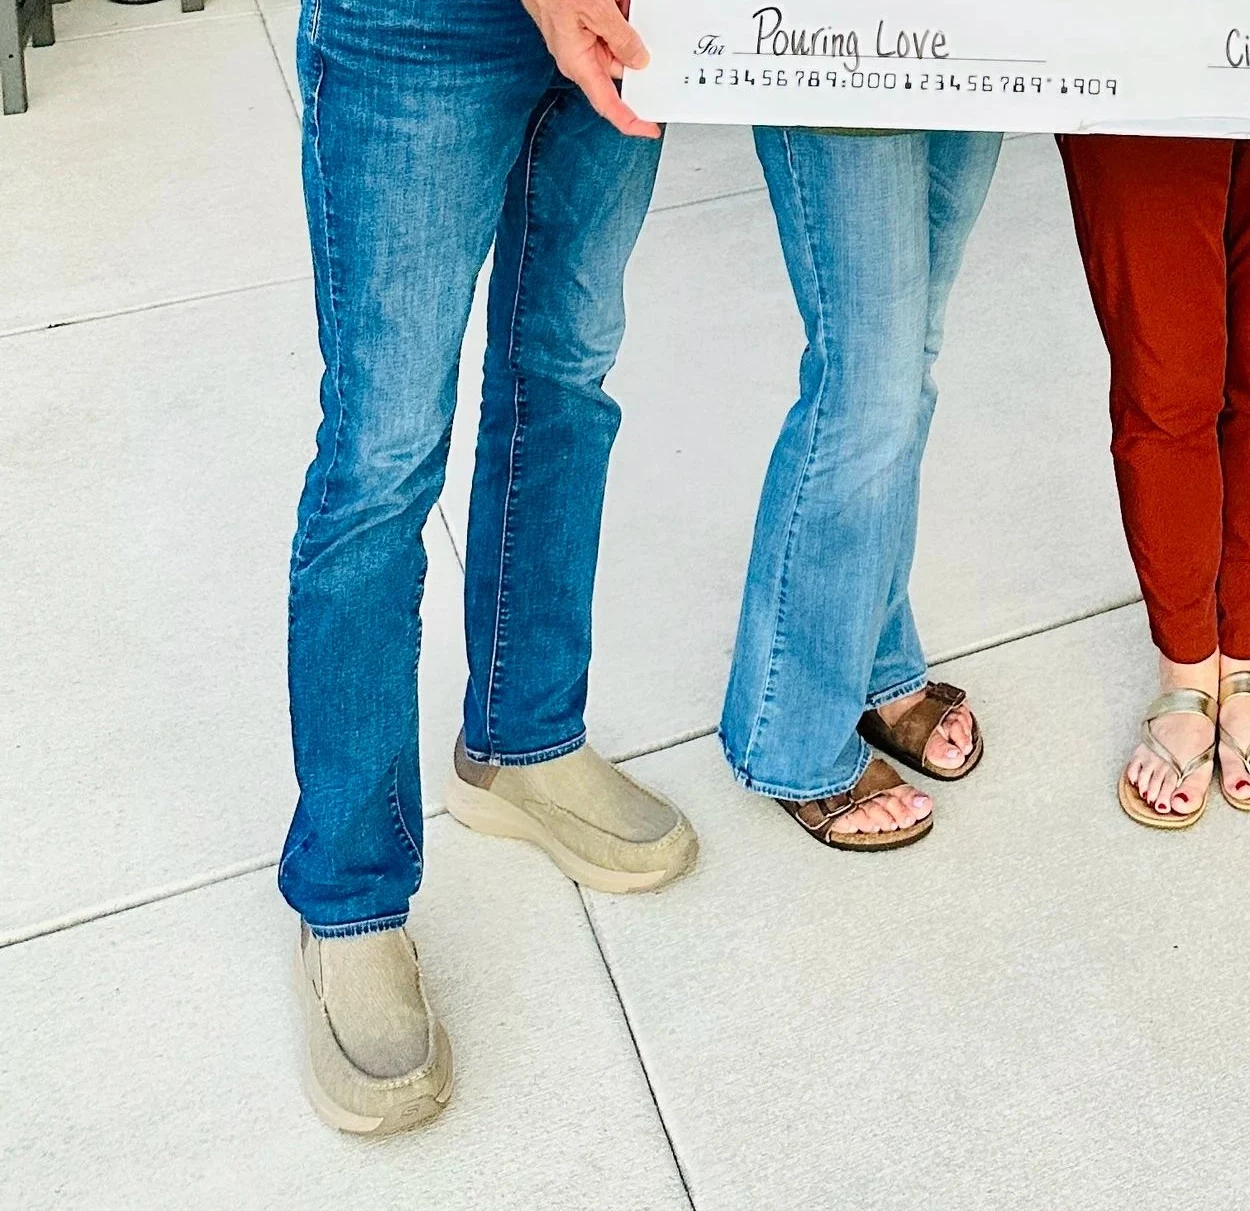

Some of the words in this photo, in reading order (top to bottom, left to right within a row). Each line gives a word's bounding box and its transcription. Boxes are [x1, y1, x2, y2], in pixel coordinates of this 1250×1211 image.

[693, 34, 726, 57] For
[752, 6, 861, 72] Pouring
[875, 20, 951, 60] Love
